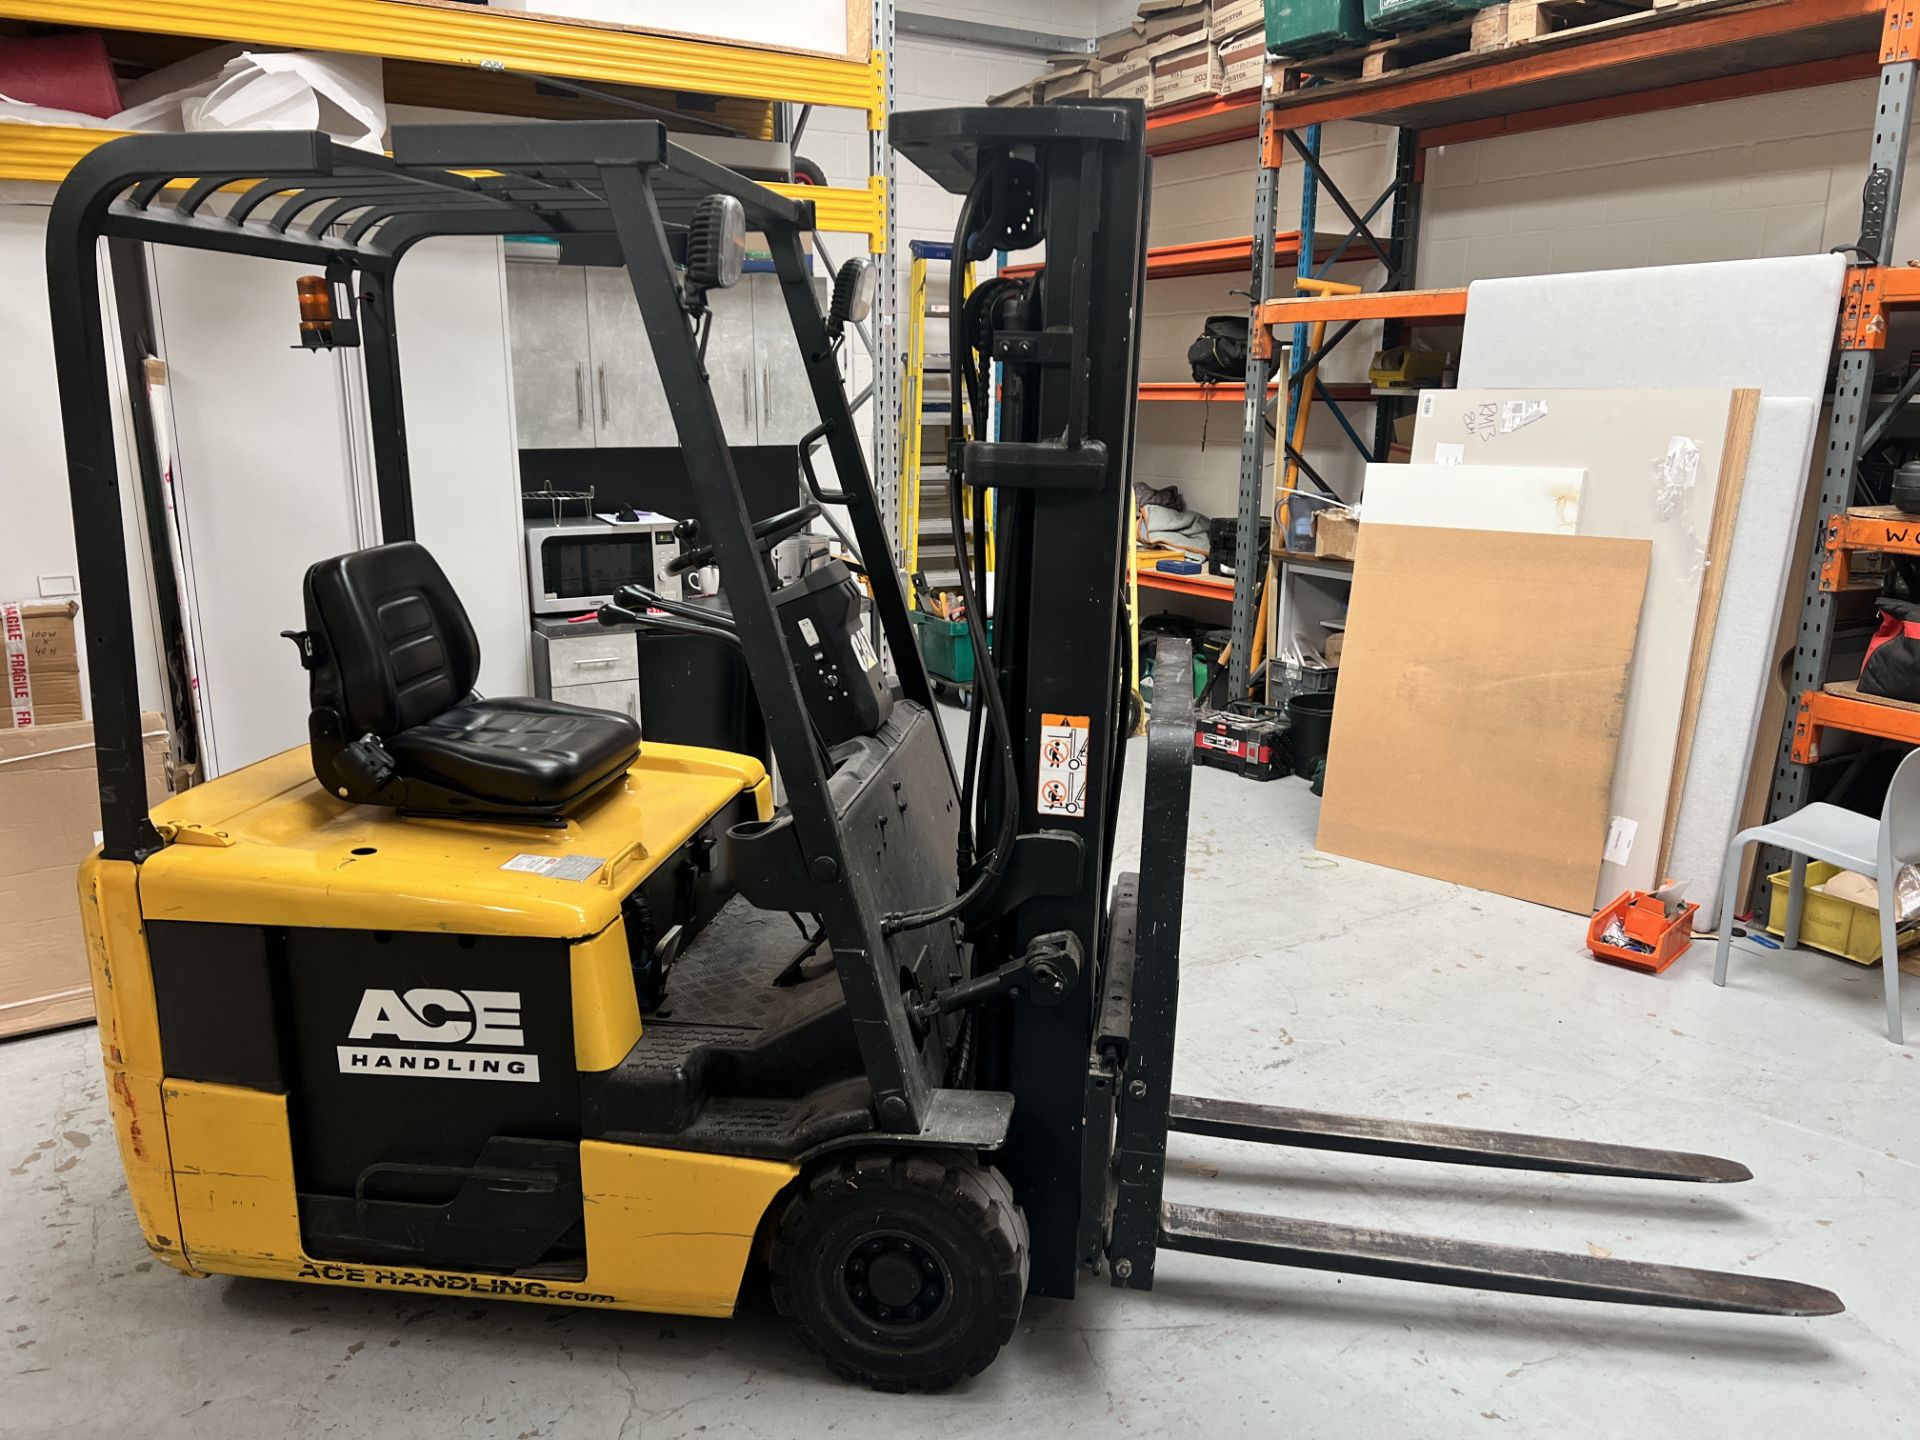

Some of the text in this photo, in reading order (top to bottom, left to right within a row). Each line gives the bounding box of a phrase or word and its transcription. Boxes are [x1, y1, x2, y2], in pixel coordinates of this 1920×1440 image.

[1135, 84, 1149, 95] 203
[1193, 73, 1208, 84] 203
[1478, 402, 1498, 442] RM13
[10, 653, 30, 699] FRAGILE
[347, 987, 525, 1047] ACE
[351, 1053, 526, 1075] HANDLING
[298, 1263, 616, 1304] ACE HANDLING.com
